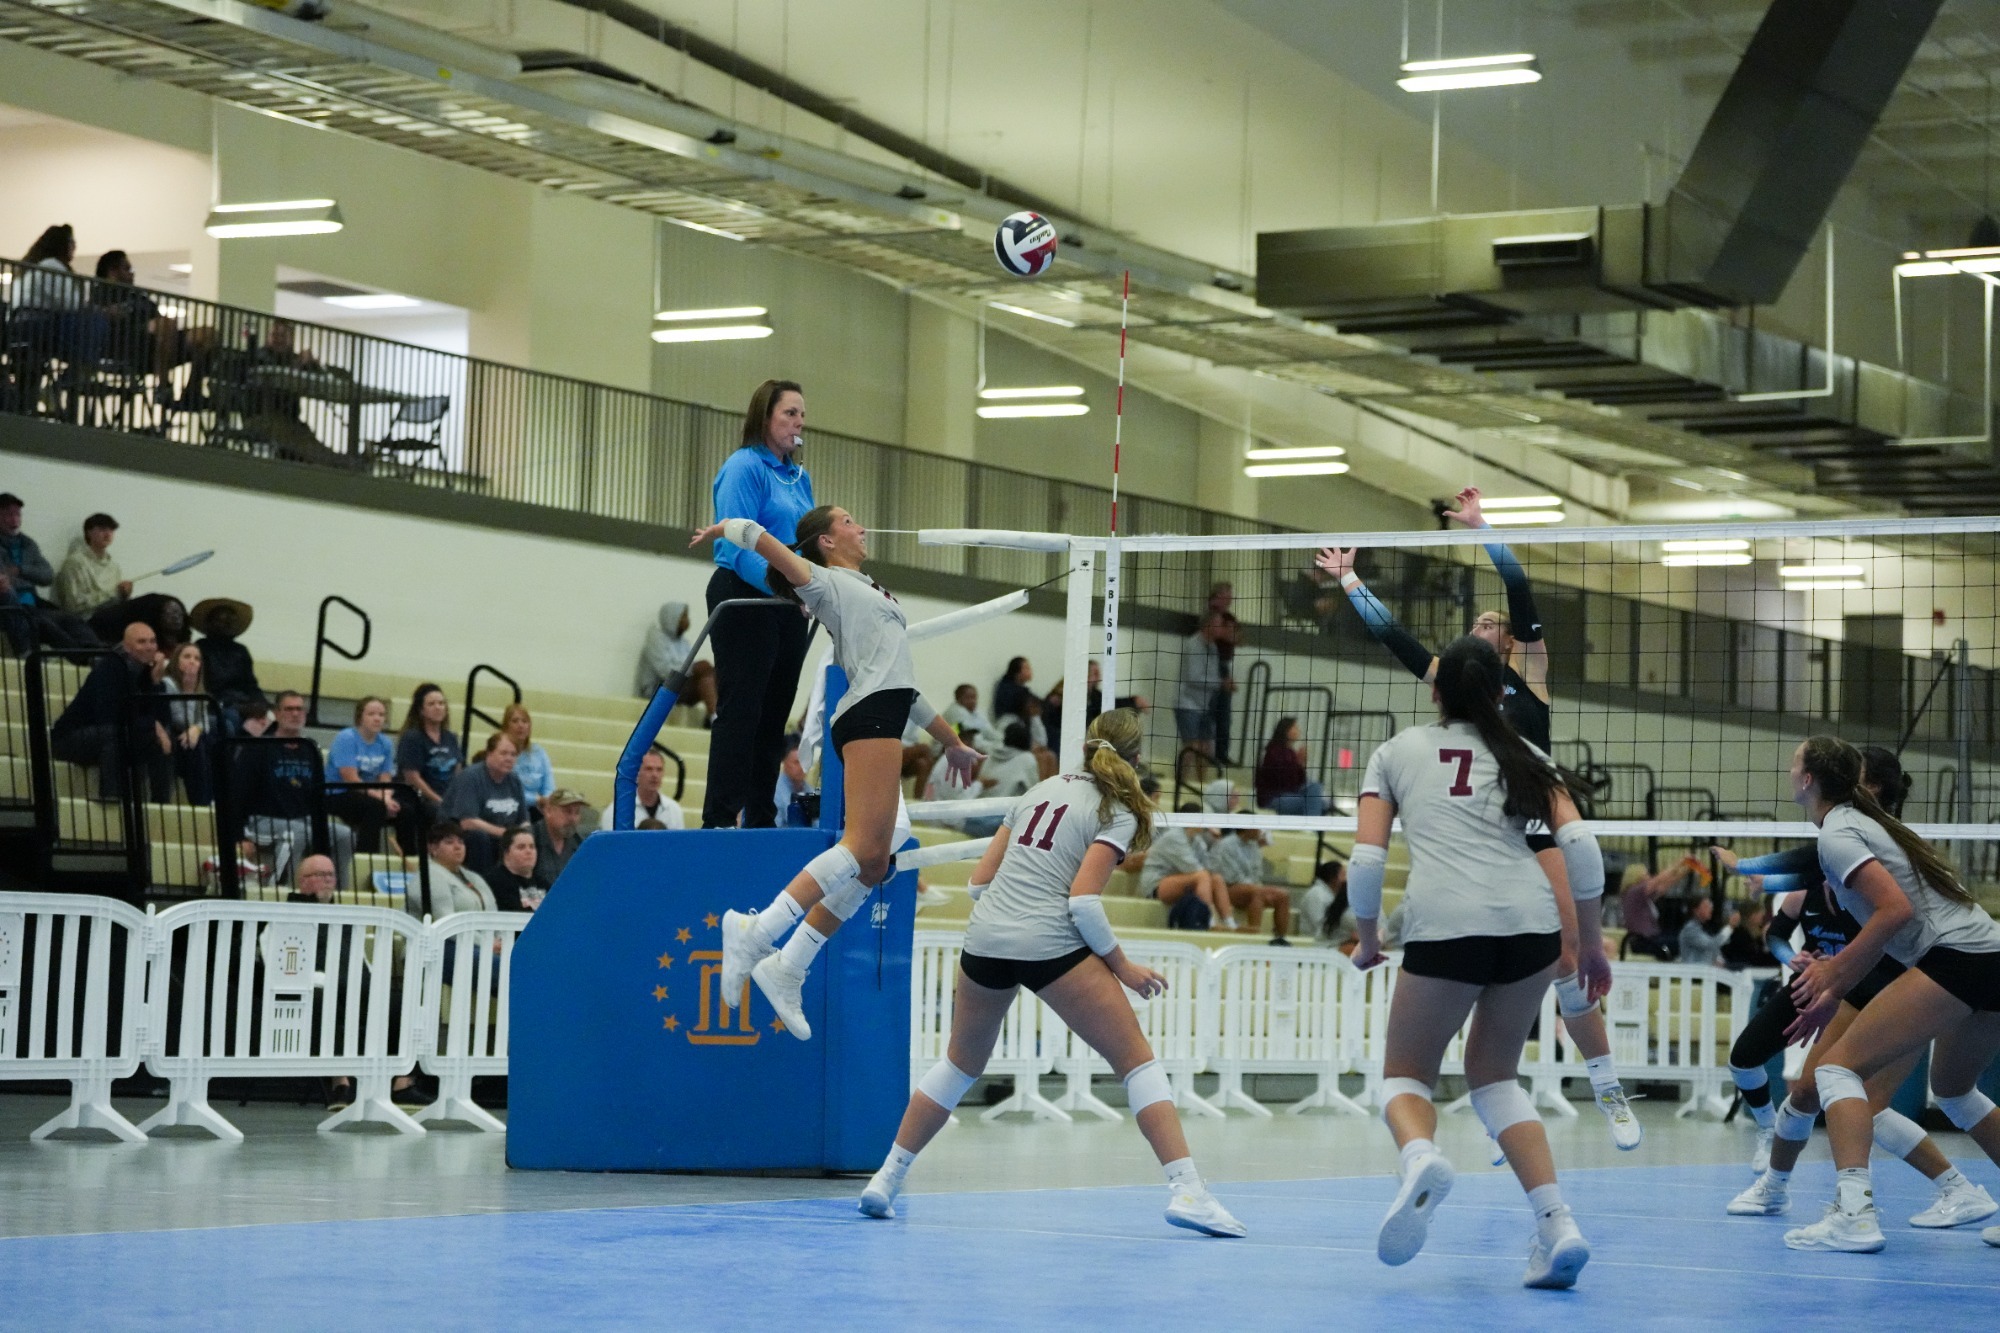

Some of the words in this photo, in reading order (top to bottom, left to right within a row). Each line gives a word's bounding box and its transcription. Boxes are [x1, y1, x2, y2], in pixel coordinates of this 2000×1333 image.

[1106, 590, 1114, 656] BISON
[1439, 748, 1473, 797] 7
[1017, 800, 1069, 852] 11
